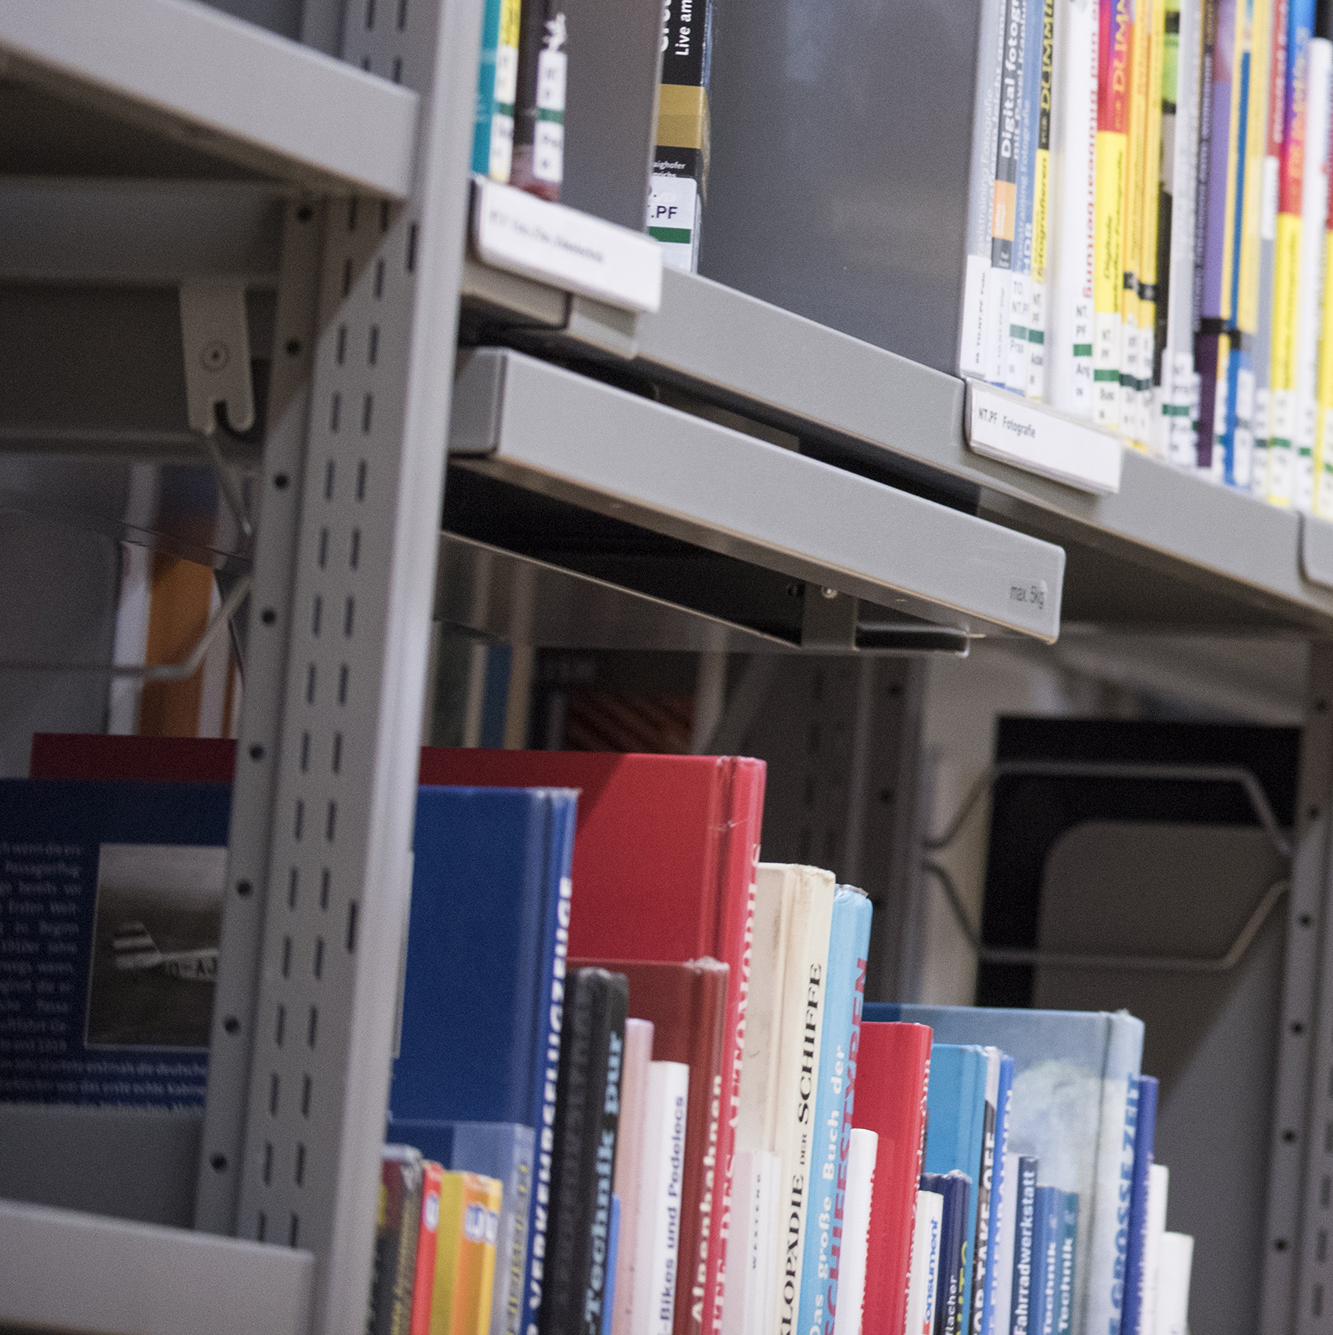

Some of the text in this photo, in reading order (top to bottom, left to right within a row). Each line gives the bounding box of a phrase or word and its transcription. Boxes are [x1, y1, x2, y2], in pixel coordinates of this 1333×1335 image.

[675, 26, 692, 56] Live
[681, 0, 695, 23] am
[1000, 76, 1016, 158] Digital
[1002, 415, 1036, 439] Fotografie
[601, 1030, 623, 1115] pur
[796, 963, 823, 1125] SCHIFFE
[828, 1045, 847, 1094] der
[666, 1095, 685, 1198] Pedelecs
[821, 1109, 842, 1180] Buch
[664, 1205, 680, 1249] und
[690, 1074, 722, 1324] Alpenbahnen
[816, 1196, 835, 1279] große
[1043, 1241, 1057, 1334] Technik
[1058, 1237, 1073, 1331] Technik
